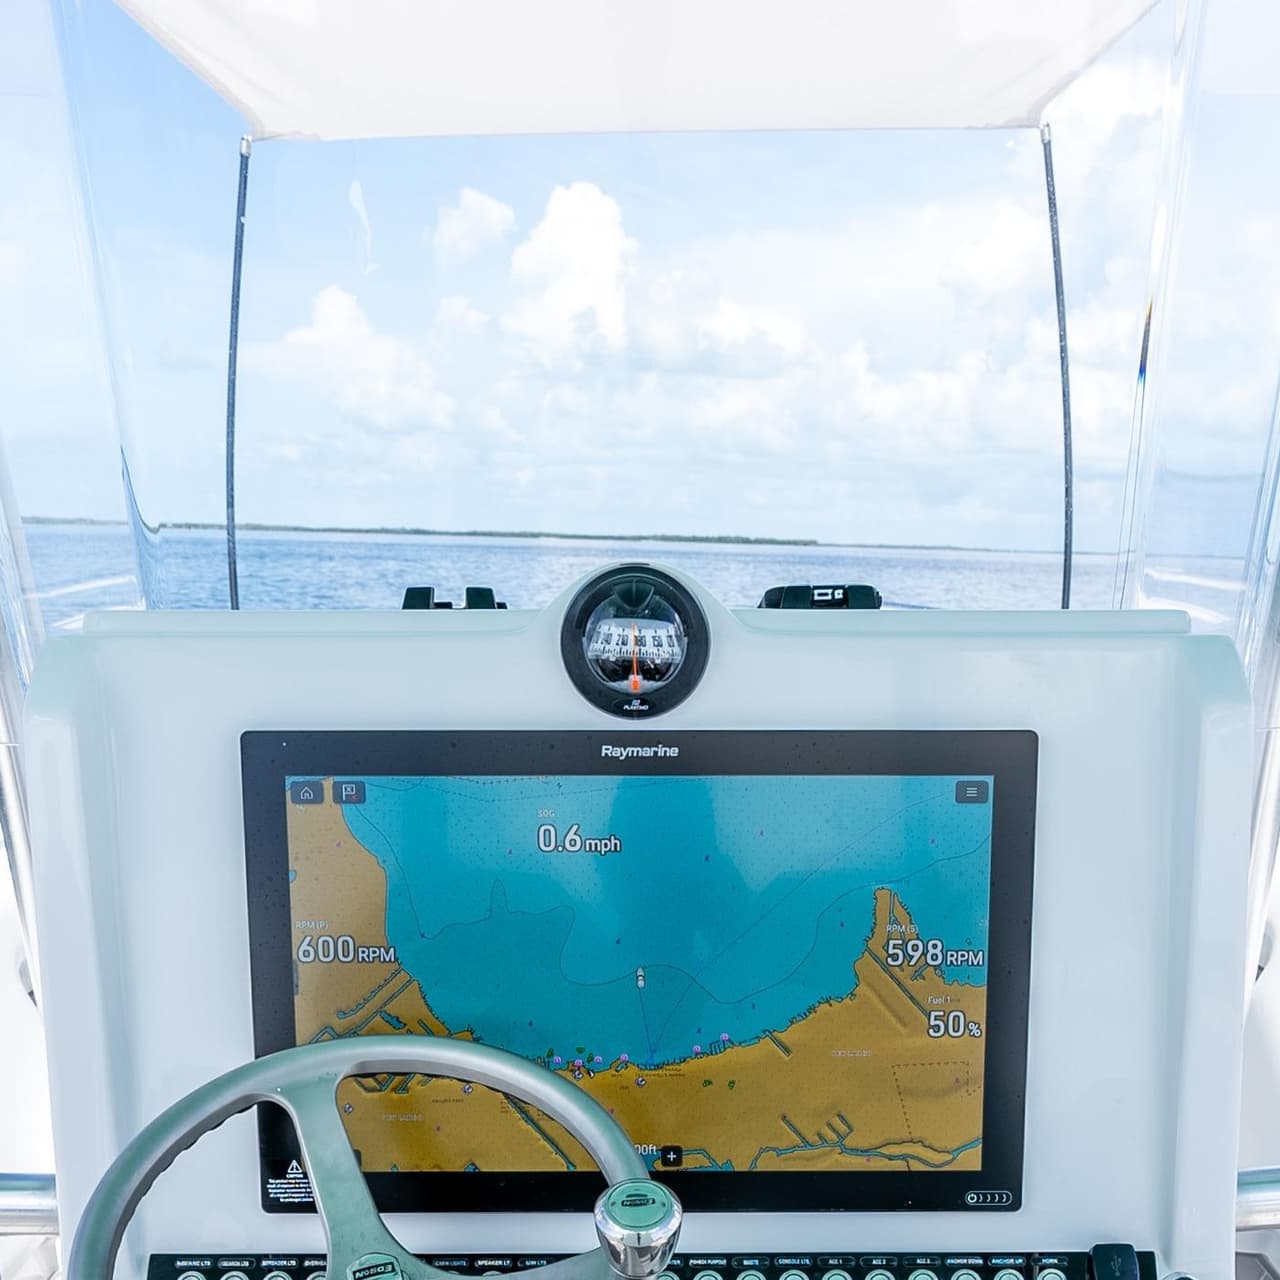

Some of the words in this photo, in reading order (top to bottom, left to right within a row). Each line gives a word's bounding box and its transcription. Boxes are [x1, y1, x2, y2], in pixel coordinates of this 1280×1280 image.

[601, 744, 679, 760] Raymarine
[537, 809, 555, 818] SOG
[538, 824, 582, 852] 0.6
[585, 835, 621, 855] mph
[296, 921, 315, 929] RPM
[886, 924, 905, 932] RPM
[298, 935, 355, 962] 600
[357, 947, 395, 962] RPM
[887, 939, 943, 966] 598
[946, 950, 984, 966] RPM
[928, 996, 945, 1005] Fuel
[355, 1264, 393, 1280] EDSON
